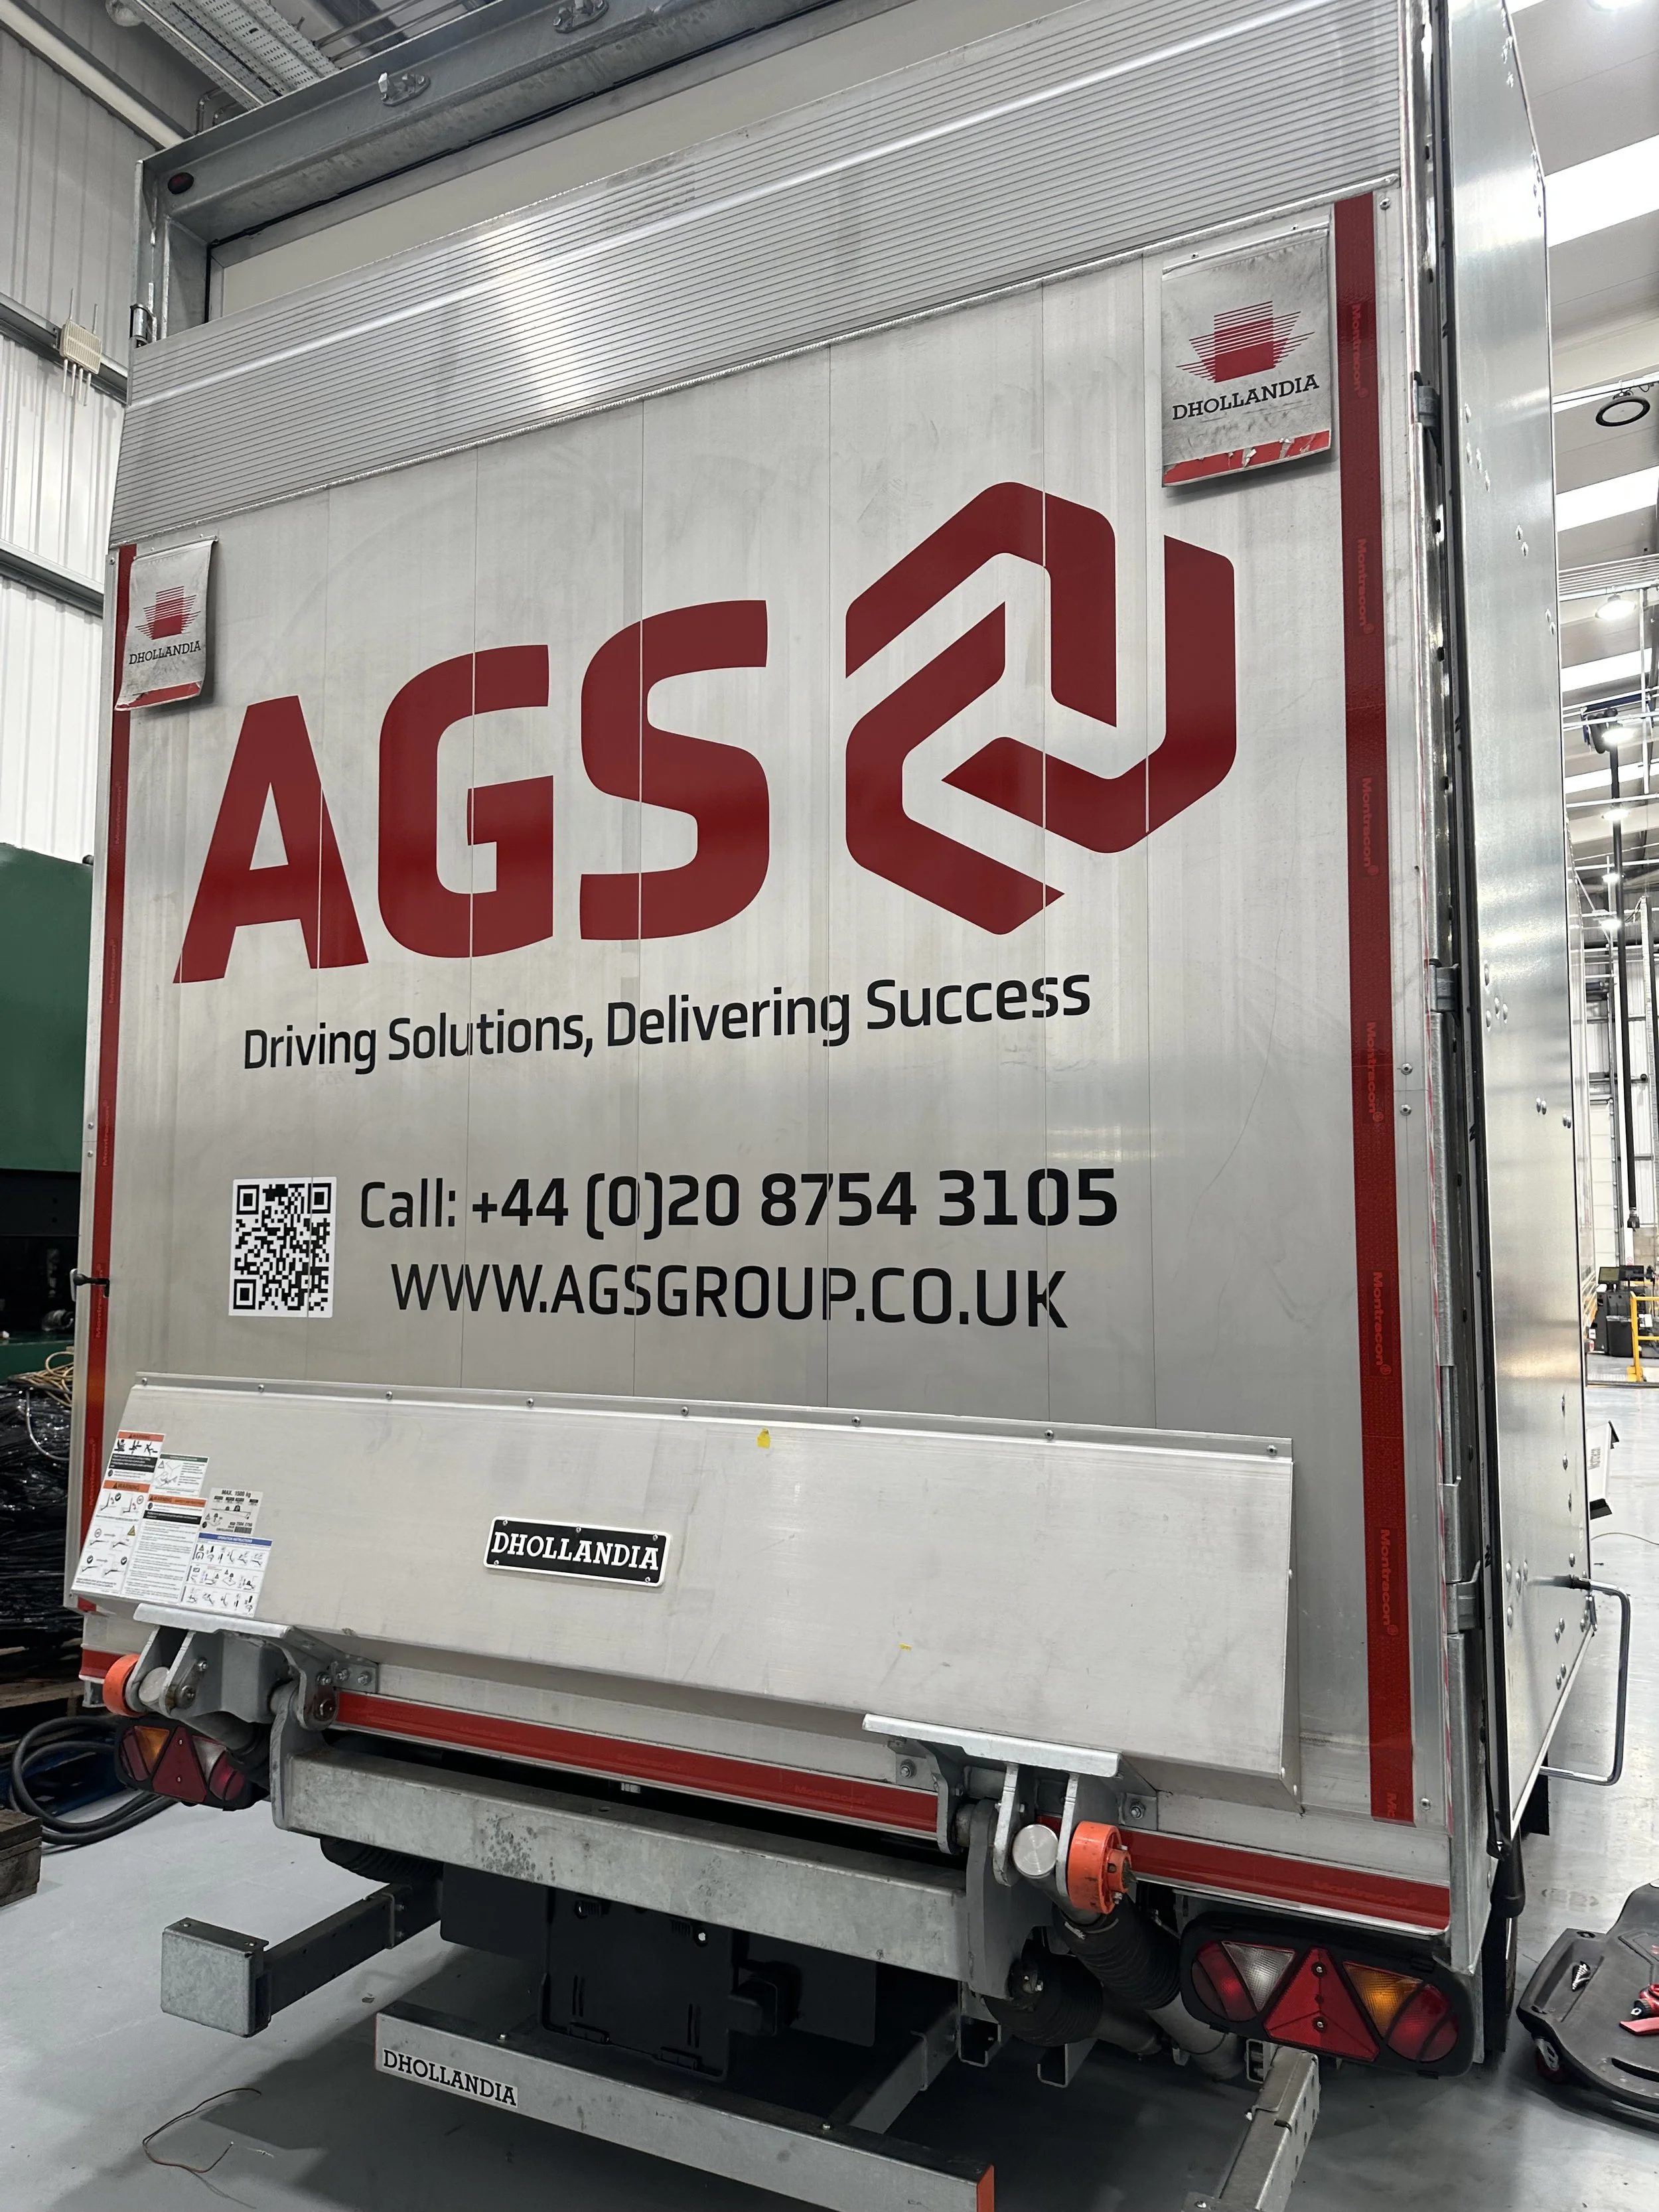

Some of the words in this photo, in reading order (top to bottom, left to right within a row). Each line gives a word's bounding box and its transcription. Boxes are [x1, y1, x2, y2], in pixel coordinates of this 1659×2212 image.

[1172, 374, 1320, 420] DHOLLANDIA
[129, 640, 201, 664] DHOLLANDIA
[174, 599, 769, 982] AGS
[244, 1022, 376, 1075] Driving
[388, 1008, 593, 1061] Solutions,
[607, 986, 849, 1047] Delivering
[867, 974, 1090, 1029] Success
[360, 1177, 456, 1228] Call:
[472, 1177, 569, 1226] +44
[586, 1171, 739, 1240] (0)20
[761, 1171, 917, 1226] 8754
[939, 1168, 1118, 1226] 3105
[390, 1264, 1068, 1329] WWW.AGSGROUP.CO.UK
[491, 1531, 659, 1571] DHOLLANDIA
[384, 2049, 516, 2106] DHOLLANDIA
